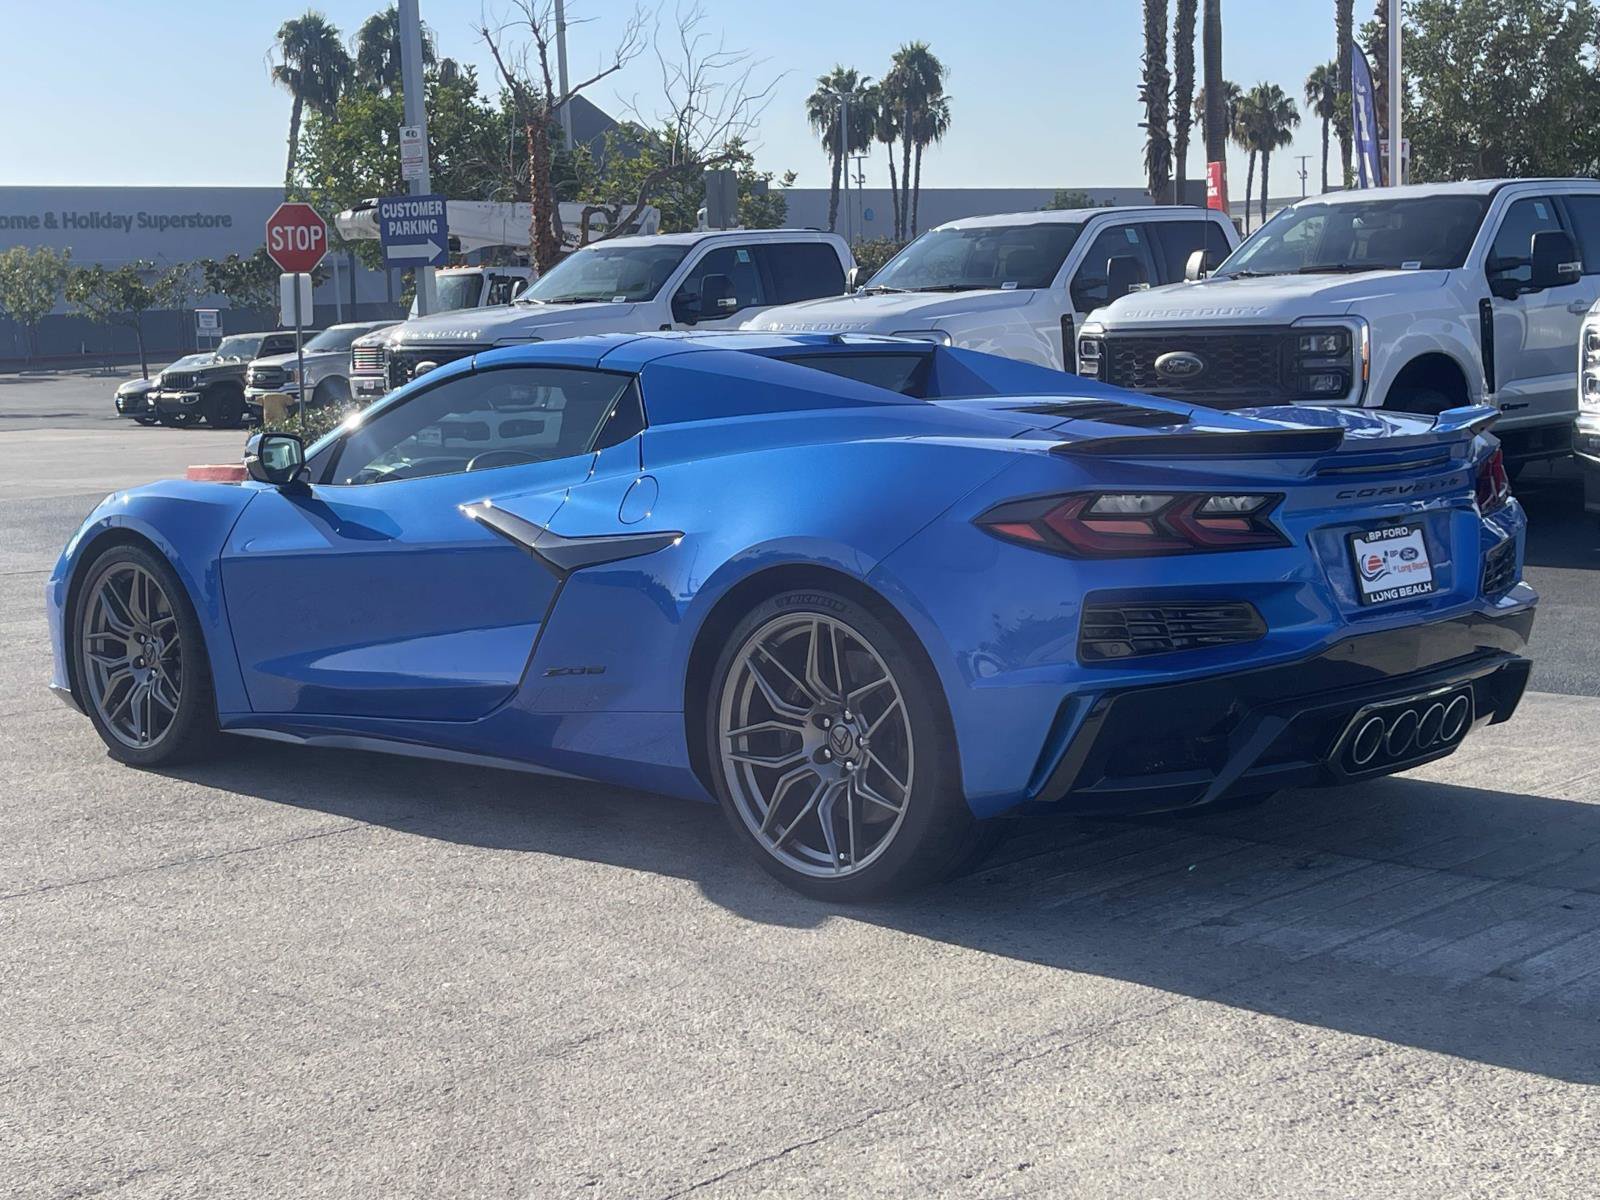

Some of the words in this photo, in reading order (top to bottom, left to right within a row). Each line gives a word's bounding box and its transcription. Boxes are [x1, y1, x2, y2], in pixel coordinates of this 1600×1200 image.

[381, 200, 443, 218] CUSTOMER
[43, 211, 59, 229] &
[62, 211, 133, 233] Holiday
[136, 211, 233, 232] Superstore
[388, 219, 438, 236] PARKING
[271, 226, 322, 251] STOP
[1199, 304, 1267, 317] DUTY
[1368, 531, 1381, 541] BP
[1382, 526, 1408, 539] FORD
[1399, 582, 1432, 597] BEACH
